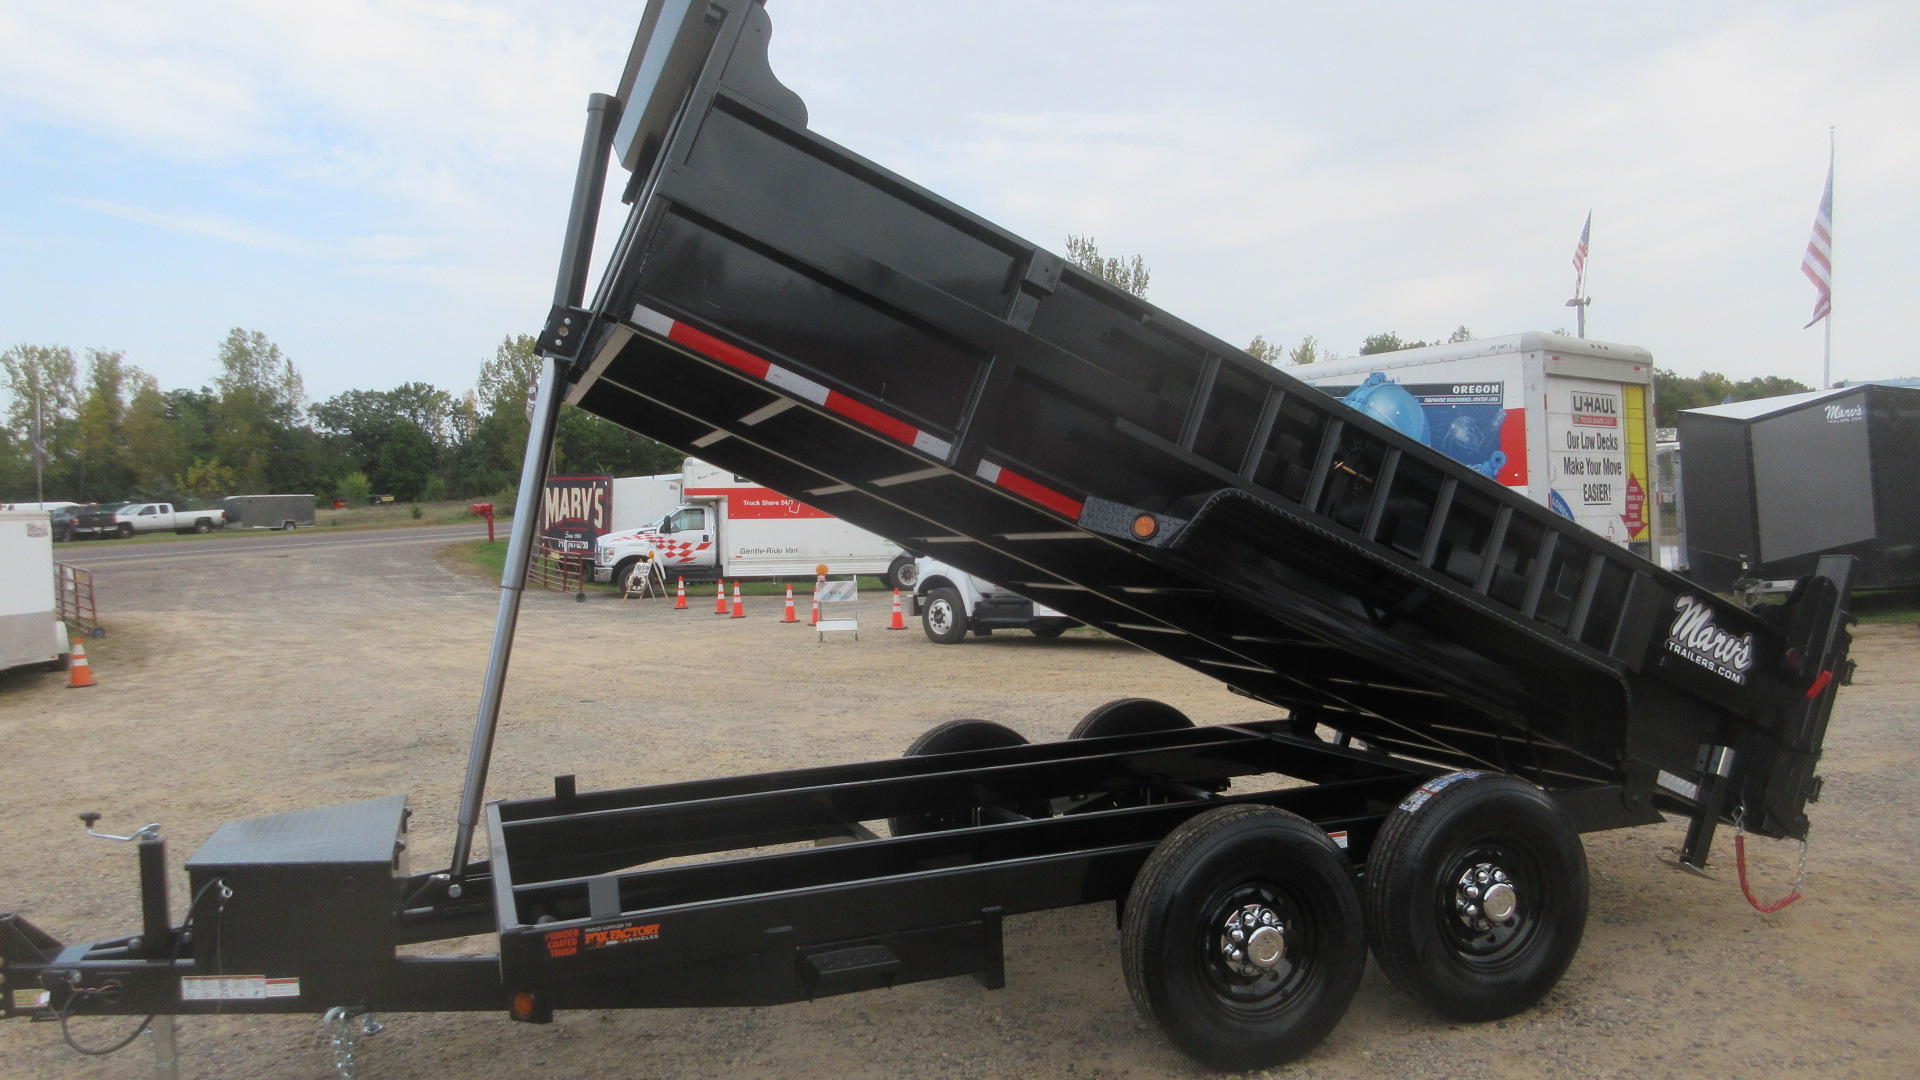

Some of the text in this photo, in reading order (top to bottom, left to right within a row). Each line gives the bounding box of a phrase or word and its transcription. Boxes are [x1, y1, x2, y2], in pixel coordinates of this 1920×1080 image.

[1452, 384, 1499, 394] OREGON
[1573, 395, 1616, 414] U-HAUL
[1566, 430, 1618, 451] Our Low Decks
[1563, 456, 1622, 475] Make Your Move
[1583, 483, 1611, 501] EASIER!
[740, 547, 783, 555] Gentle-Ride
[1672, 594, 1750, 669] Marv's
[1668, 641, 1741, 684] TRAILERS.COM
[609, 924, 660, 940] FACTORY
[623, 934, 659, 943] VEHICLES
[547, 938, 578, 949] COATED
